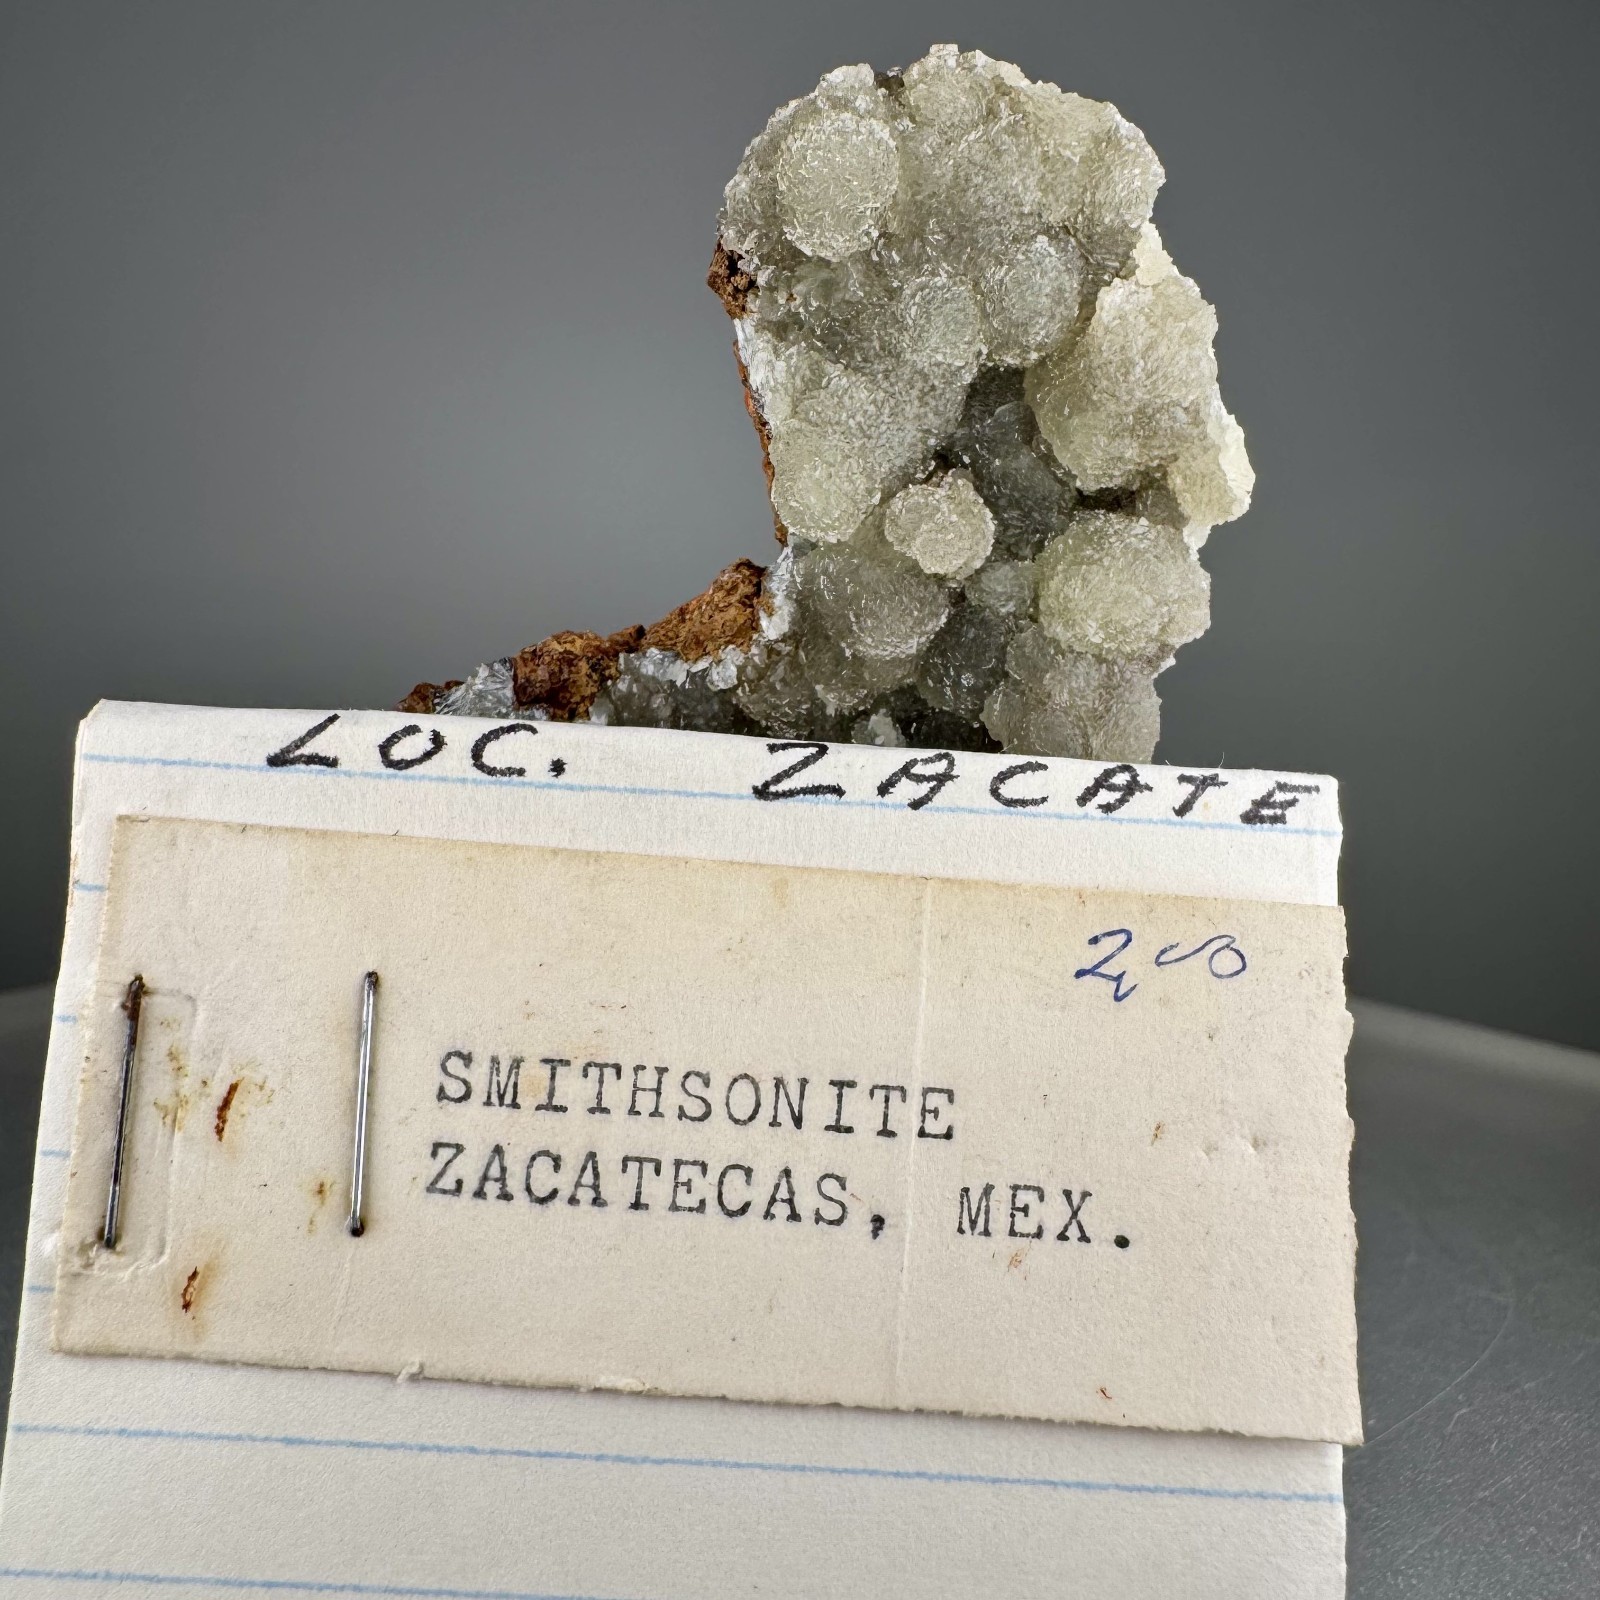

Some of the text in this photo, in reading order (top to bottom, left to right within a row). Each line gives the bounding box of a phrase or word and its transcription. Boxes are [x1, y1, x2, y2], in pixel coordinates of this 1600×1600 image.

[266, 712, 1322, 827] LOC. ZACATE
[435, 1049, 956, 1141] SMITHSONITE
[425, 1141, 1132, 1250] ZACATECAS, MEX.
